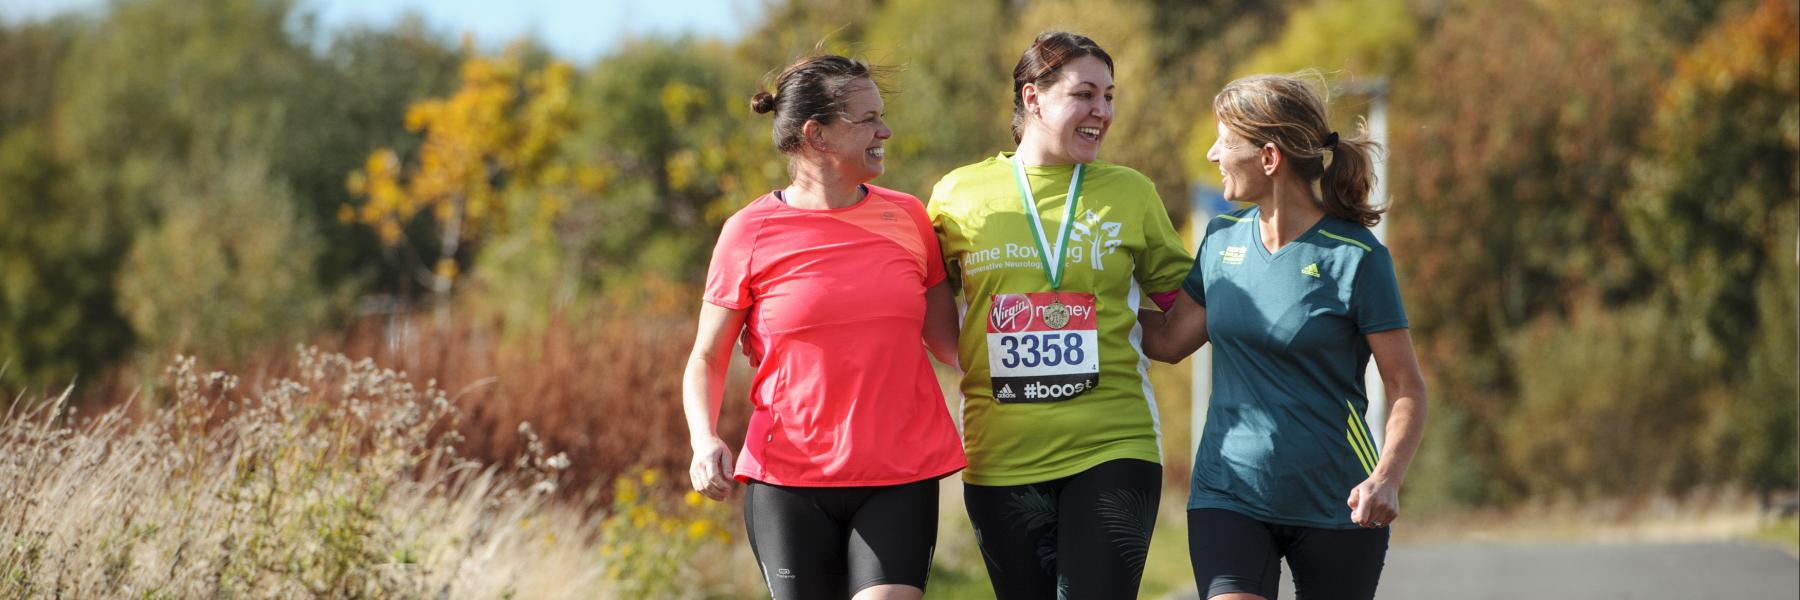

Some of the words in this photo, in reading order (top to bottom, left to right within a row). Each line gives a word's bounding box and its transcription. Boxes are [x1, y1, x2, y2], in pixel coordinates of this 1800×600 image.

[965, 247, 1001, 266] Anne
[993, 295, 1029, 329] Virgin
[1036, 304, 1091, 320] mney
[1000, 332, 1084, 368] 3358
[1024, 379, 1092, 399] #boost
